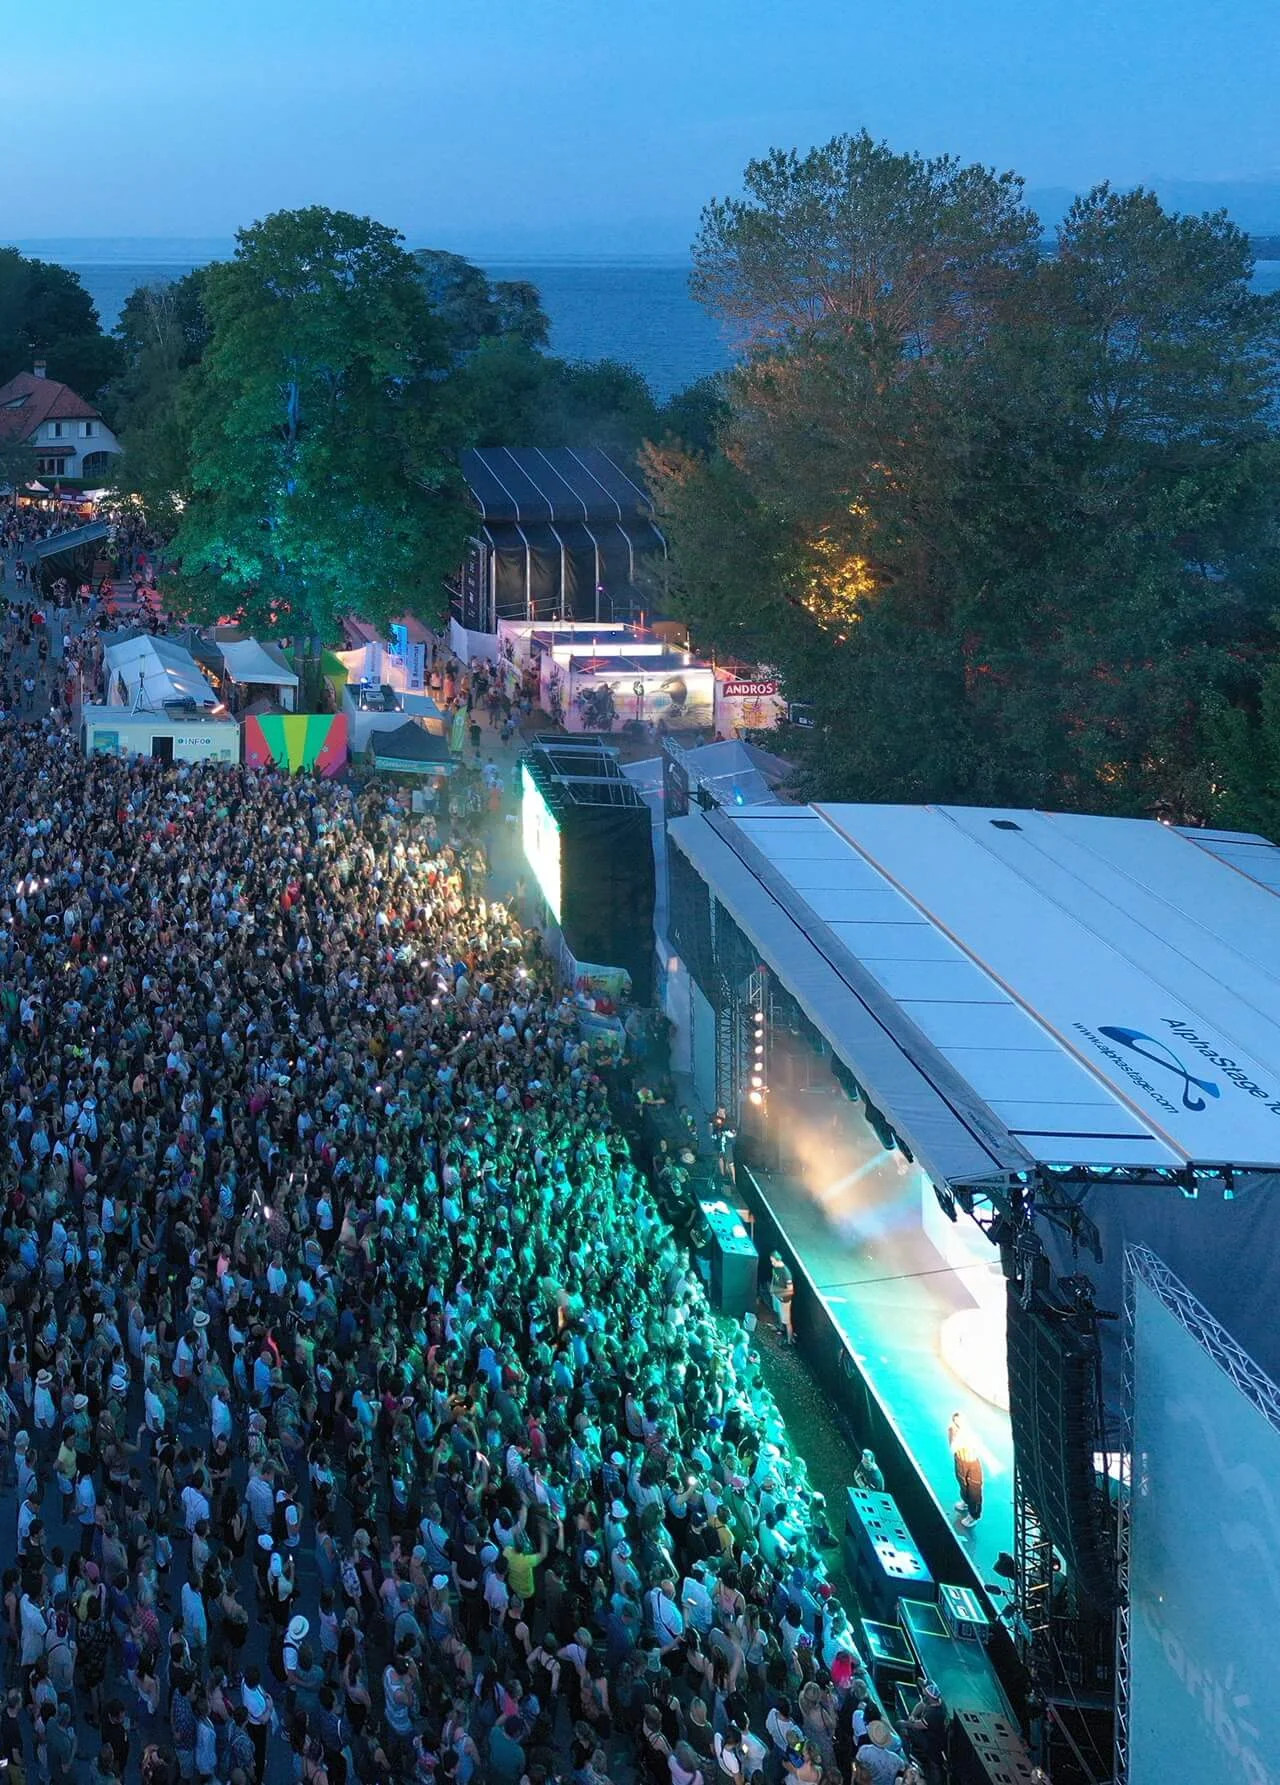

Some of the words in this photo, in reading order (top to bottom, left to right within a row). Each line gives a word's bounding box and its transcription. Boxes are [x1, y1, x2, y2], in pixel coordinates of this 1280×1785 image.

[725, 682, 773, 695] ANDROS
[1072, 1022, 1179, 1114] www.alphastage.com
[1159, 1017, 1269, 1099] AlphaStage
